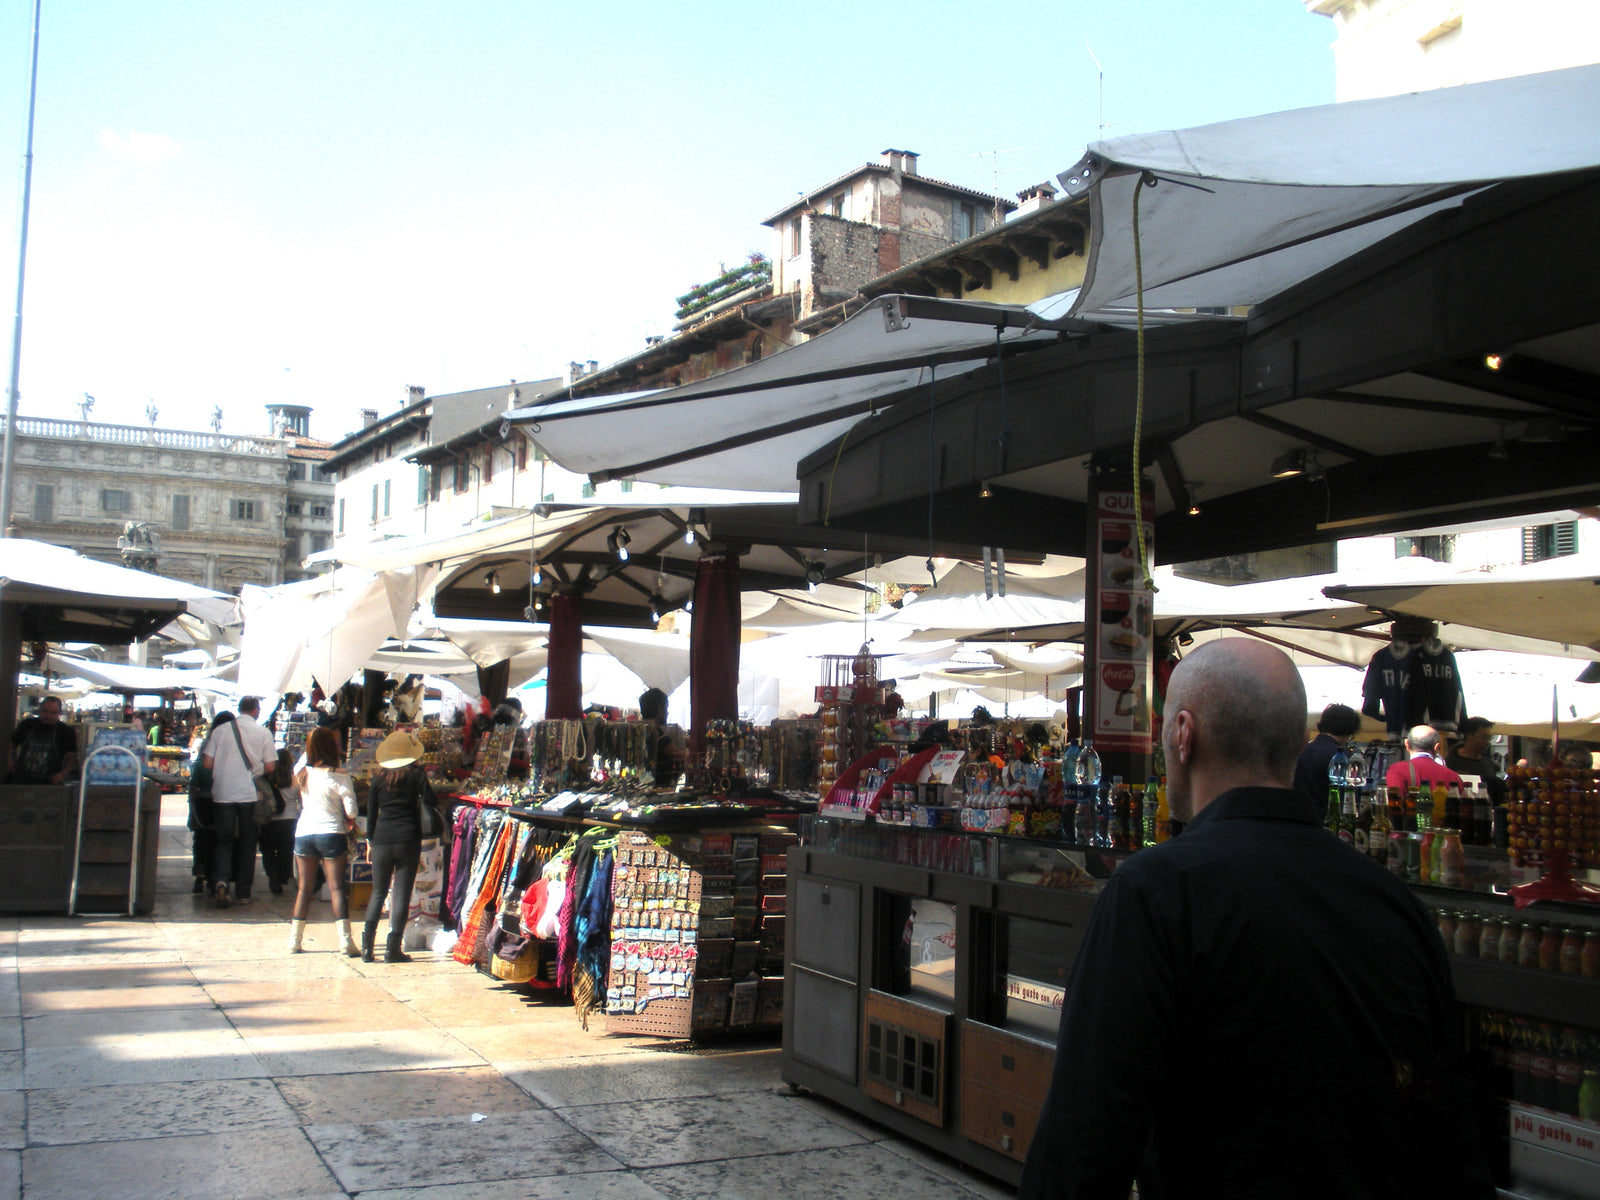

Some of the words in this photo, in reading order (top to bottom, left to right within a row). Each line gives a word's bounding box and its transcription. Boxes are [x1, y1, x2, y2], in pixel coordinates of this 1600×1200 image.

[1022, 987, 1040, 1000] gusto
[1041, 993, 1050, 1003] con
[1514, 1115, 1533, 1132] più
[1538, 1123, 1572, 1143] gusto
[1576, 1136, 1594, 1150] con
